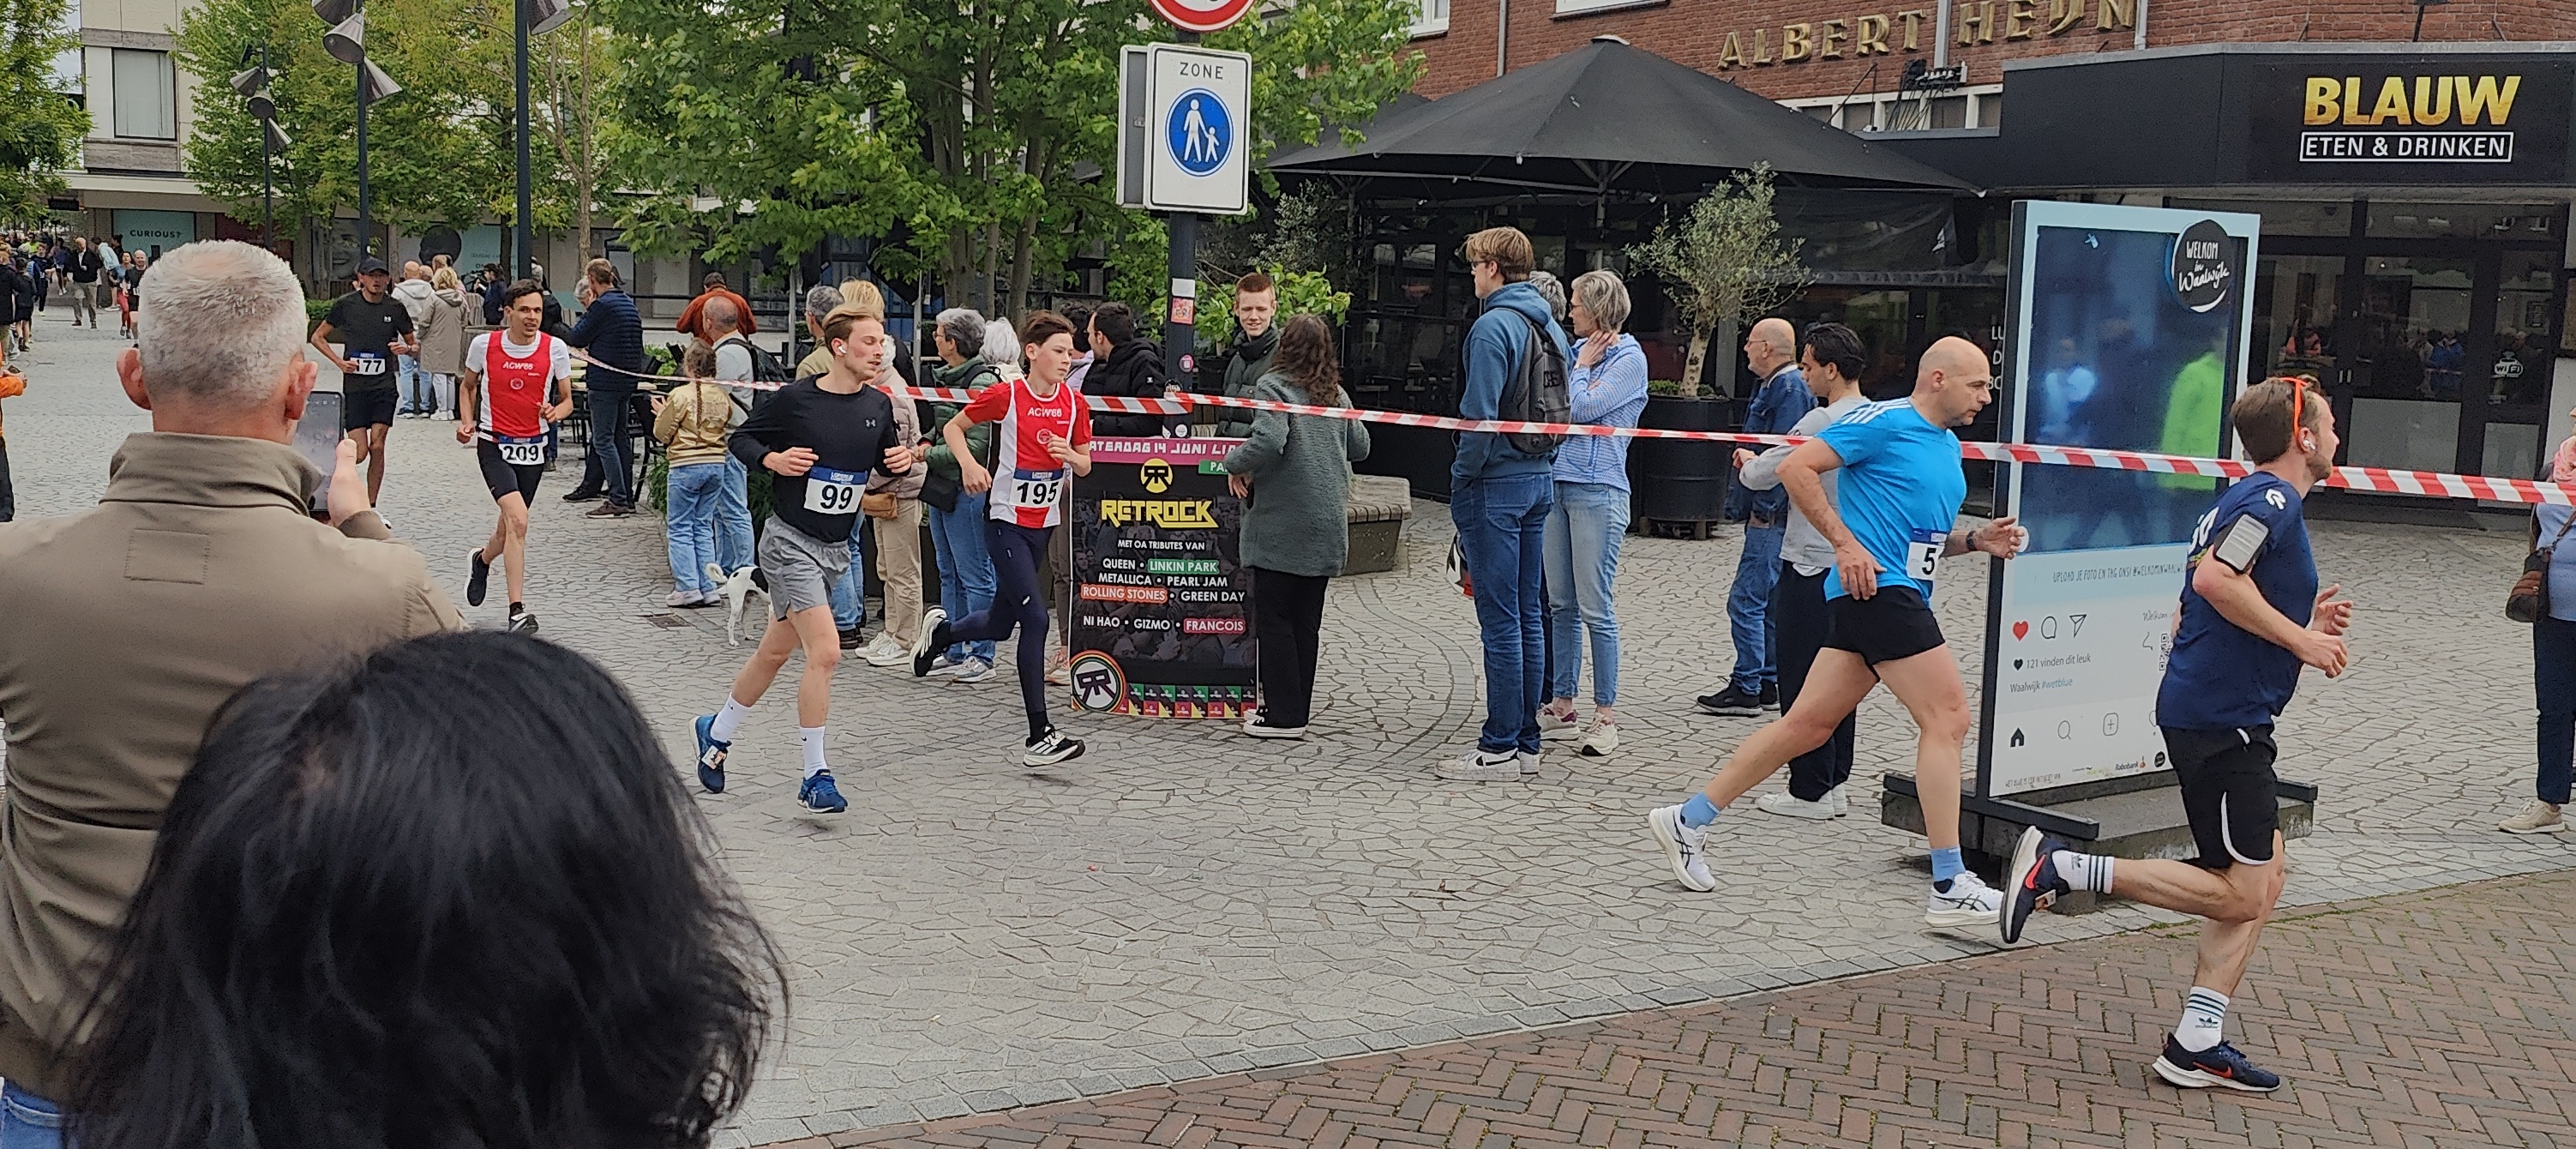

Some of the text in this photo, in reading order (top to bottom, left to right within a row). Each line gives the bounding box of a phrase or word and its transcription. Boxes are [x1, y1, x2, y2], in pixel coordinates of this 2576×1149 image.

[1717, 9, 1927, 69] ALBERT
[1180, 62, 1224, 80] ZONE
[2303, 75, 2521, 125] BLAUW
[2306, 137, 2505, 156] ETEN & DRINKEN
[129, 229, 182, 238] CURIOUS?
[2186, 241, 2219, 259] WELKOM
[2195, 260, 2204, 272] in
[2179, 261, 2230, 292] Waalwijk
[503, 445, 539, 461] 209
[1090, 441, 1150, 454] ATERDAG
[1155, 442, 1166, 454] 14
[1170, 442, 1206, 454] JUNI
[820, 484, 853, 509] 99
[1017, 481, 1059, 504] 195
[1102, 500, 1219, 528] RETROCK
[1118, 539, 1205, 550] MET OA TRIBUTES VAN
[1102, 558, 1218, 572] QUEEN LINKIN PARK
[1922, 546, 1937, 575] 5
[1098, 573, 1228, 587] METALLICA PEARL JAM
[2053, 571, 2074, 583] UPLOAD
[2075, 569, 2083, 581] JE
[2084, 569, 2097, 580] FOTO
[2098, 568, 2106, 579] EN
[2107, 568, 2117, 579] TAG
[1083, 586, 1245, 602] ROLLING STONES GREEN DAY
[1084, 616, 1244, 631] NI HAO GIZMO FRANCOIS
[2027, 653, 2091, 669] 121 vinden dit leuk
[2009, 680, 2040, 693] Waalwijk
[2115, 761, 2139, 771] Rabobank
